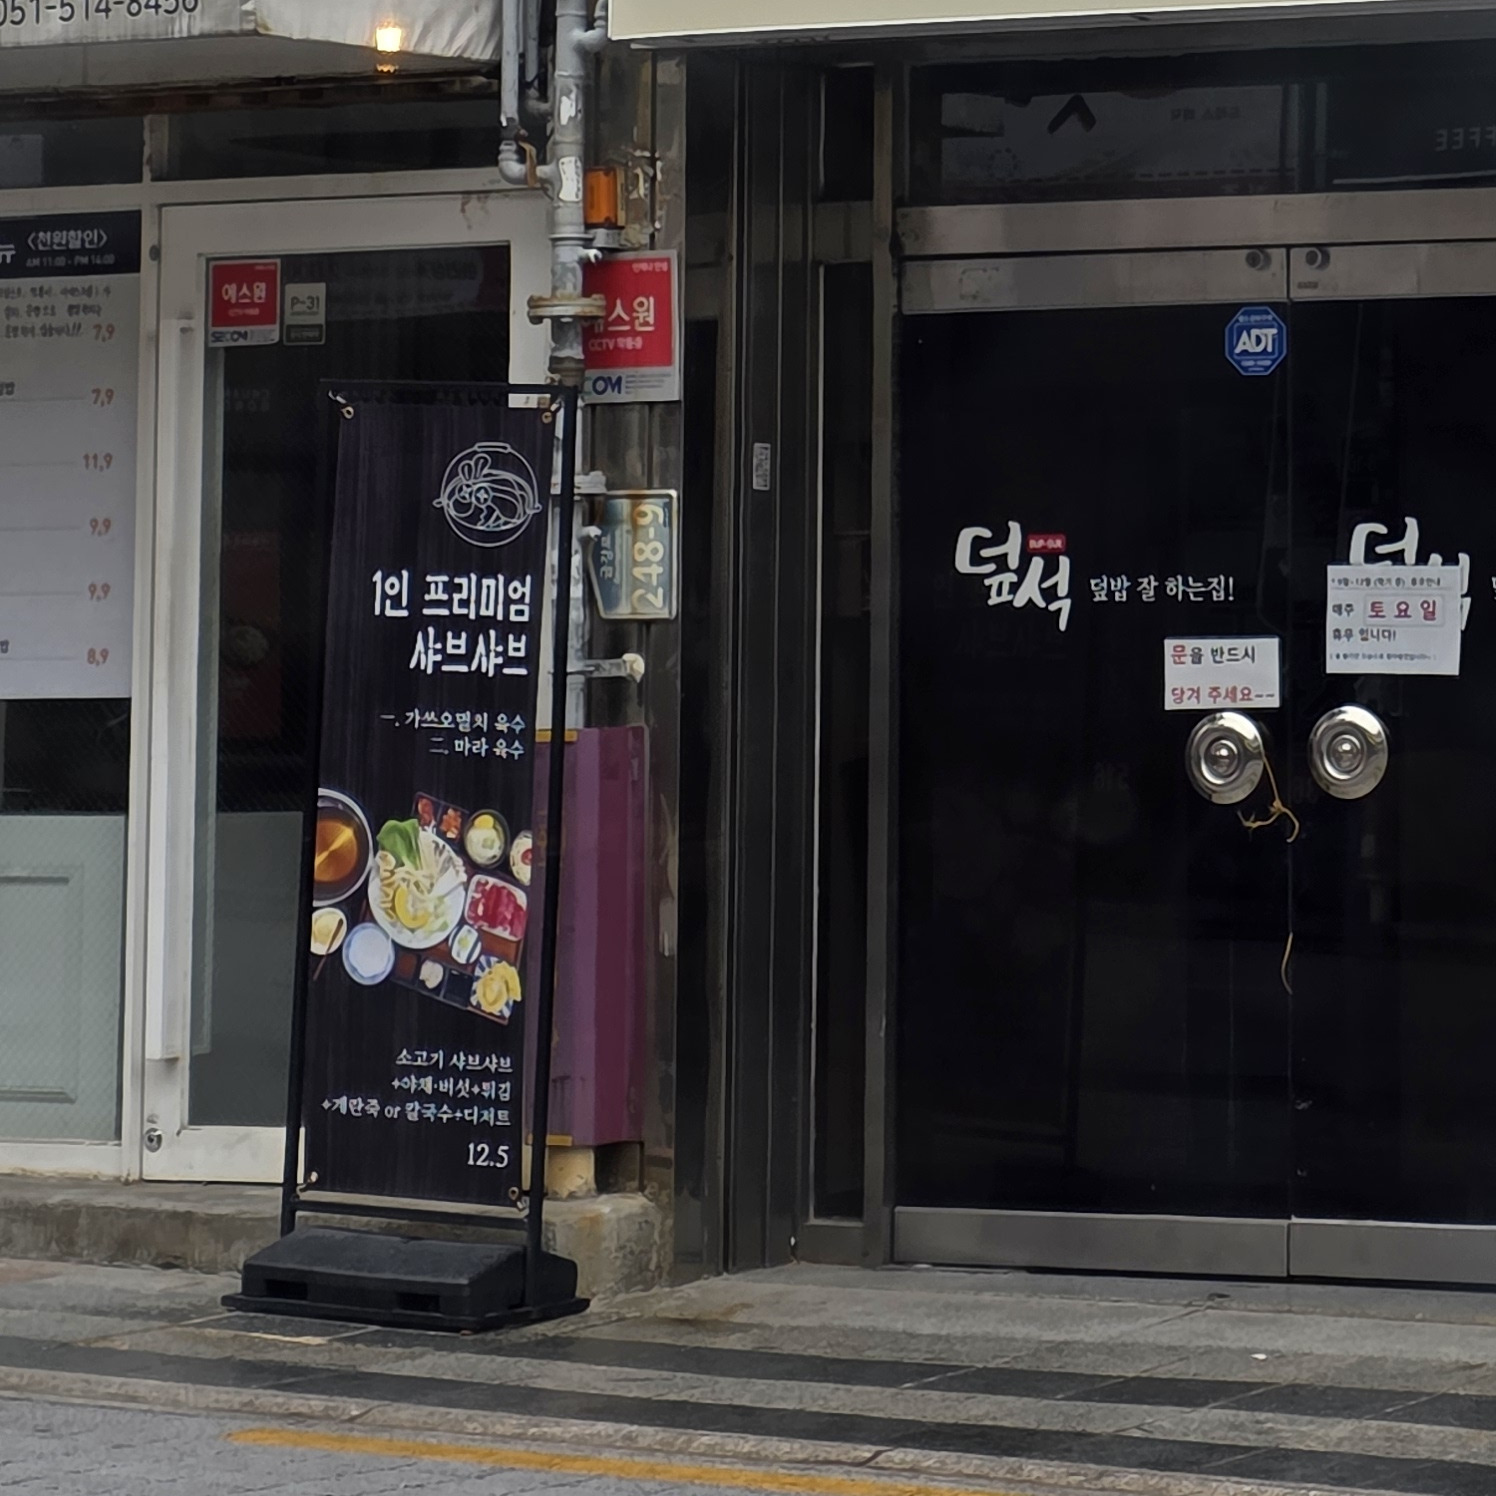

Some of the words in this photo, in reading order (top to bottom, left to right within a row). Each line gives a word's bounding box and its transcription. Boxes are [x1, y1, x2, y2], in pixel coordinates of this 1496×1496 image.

[1233, 327, 1279, 354] ADT
[631, 504, 665, 609] 248-9
[954, 520, 1072, 632] 덮석
[1090, 575, 1131, 602] 덮밥
[1136, 575, 1159, 602] 잘
[1165, 575, 1235, 602] 하는집!
[372, 569, 409, 618] 1인
[422, 572, 532, 622] 프리미엄
[1368, 599, 1437, 621] 토요일
[409, 626, 529, 678] 샤브샤브
[1171, 644, 1204, 665] 문을
[1211, 645, 1256, 665] 반드시
[1171, 686, 1201, 704] 당겨
[454, 735, 489, 758] 마라
[395, 1048, 445, 1070] 소고기
[449, 1050, 514, 1074] 샤브샤브
[384, 1106, 402, 1119] or
[466, 1142, 511, 1168] 12.5
